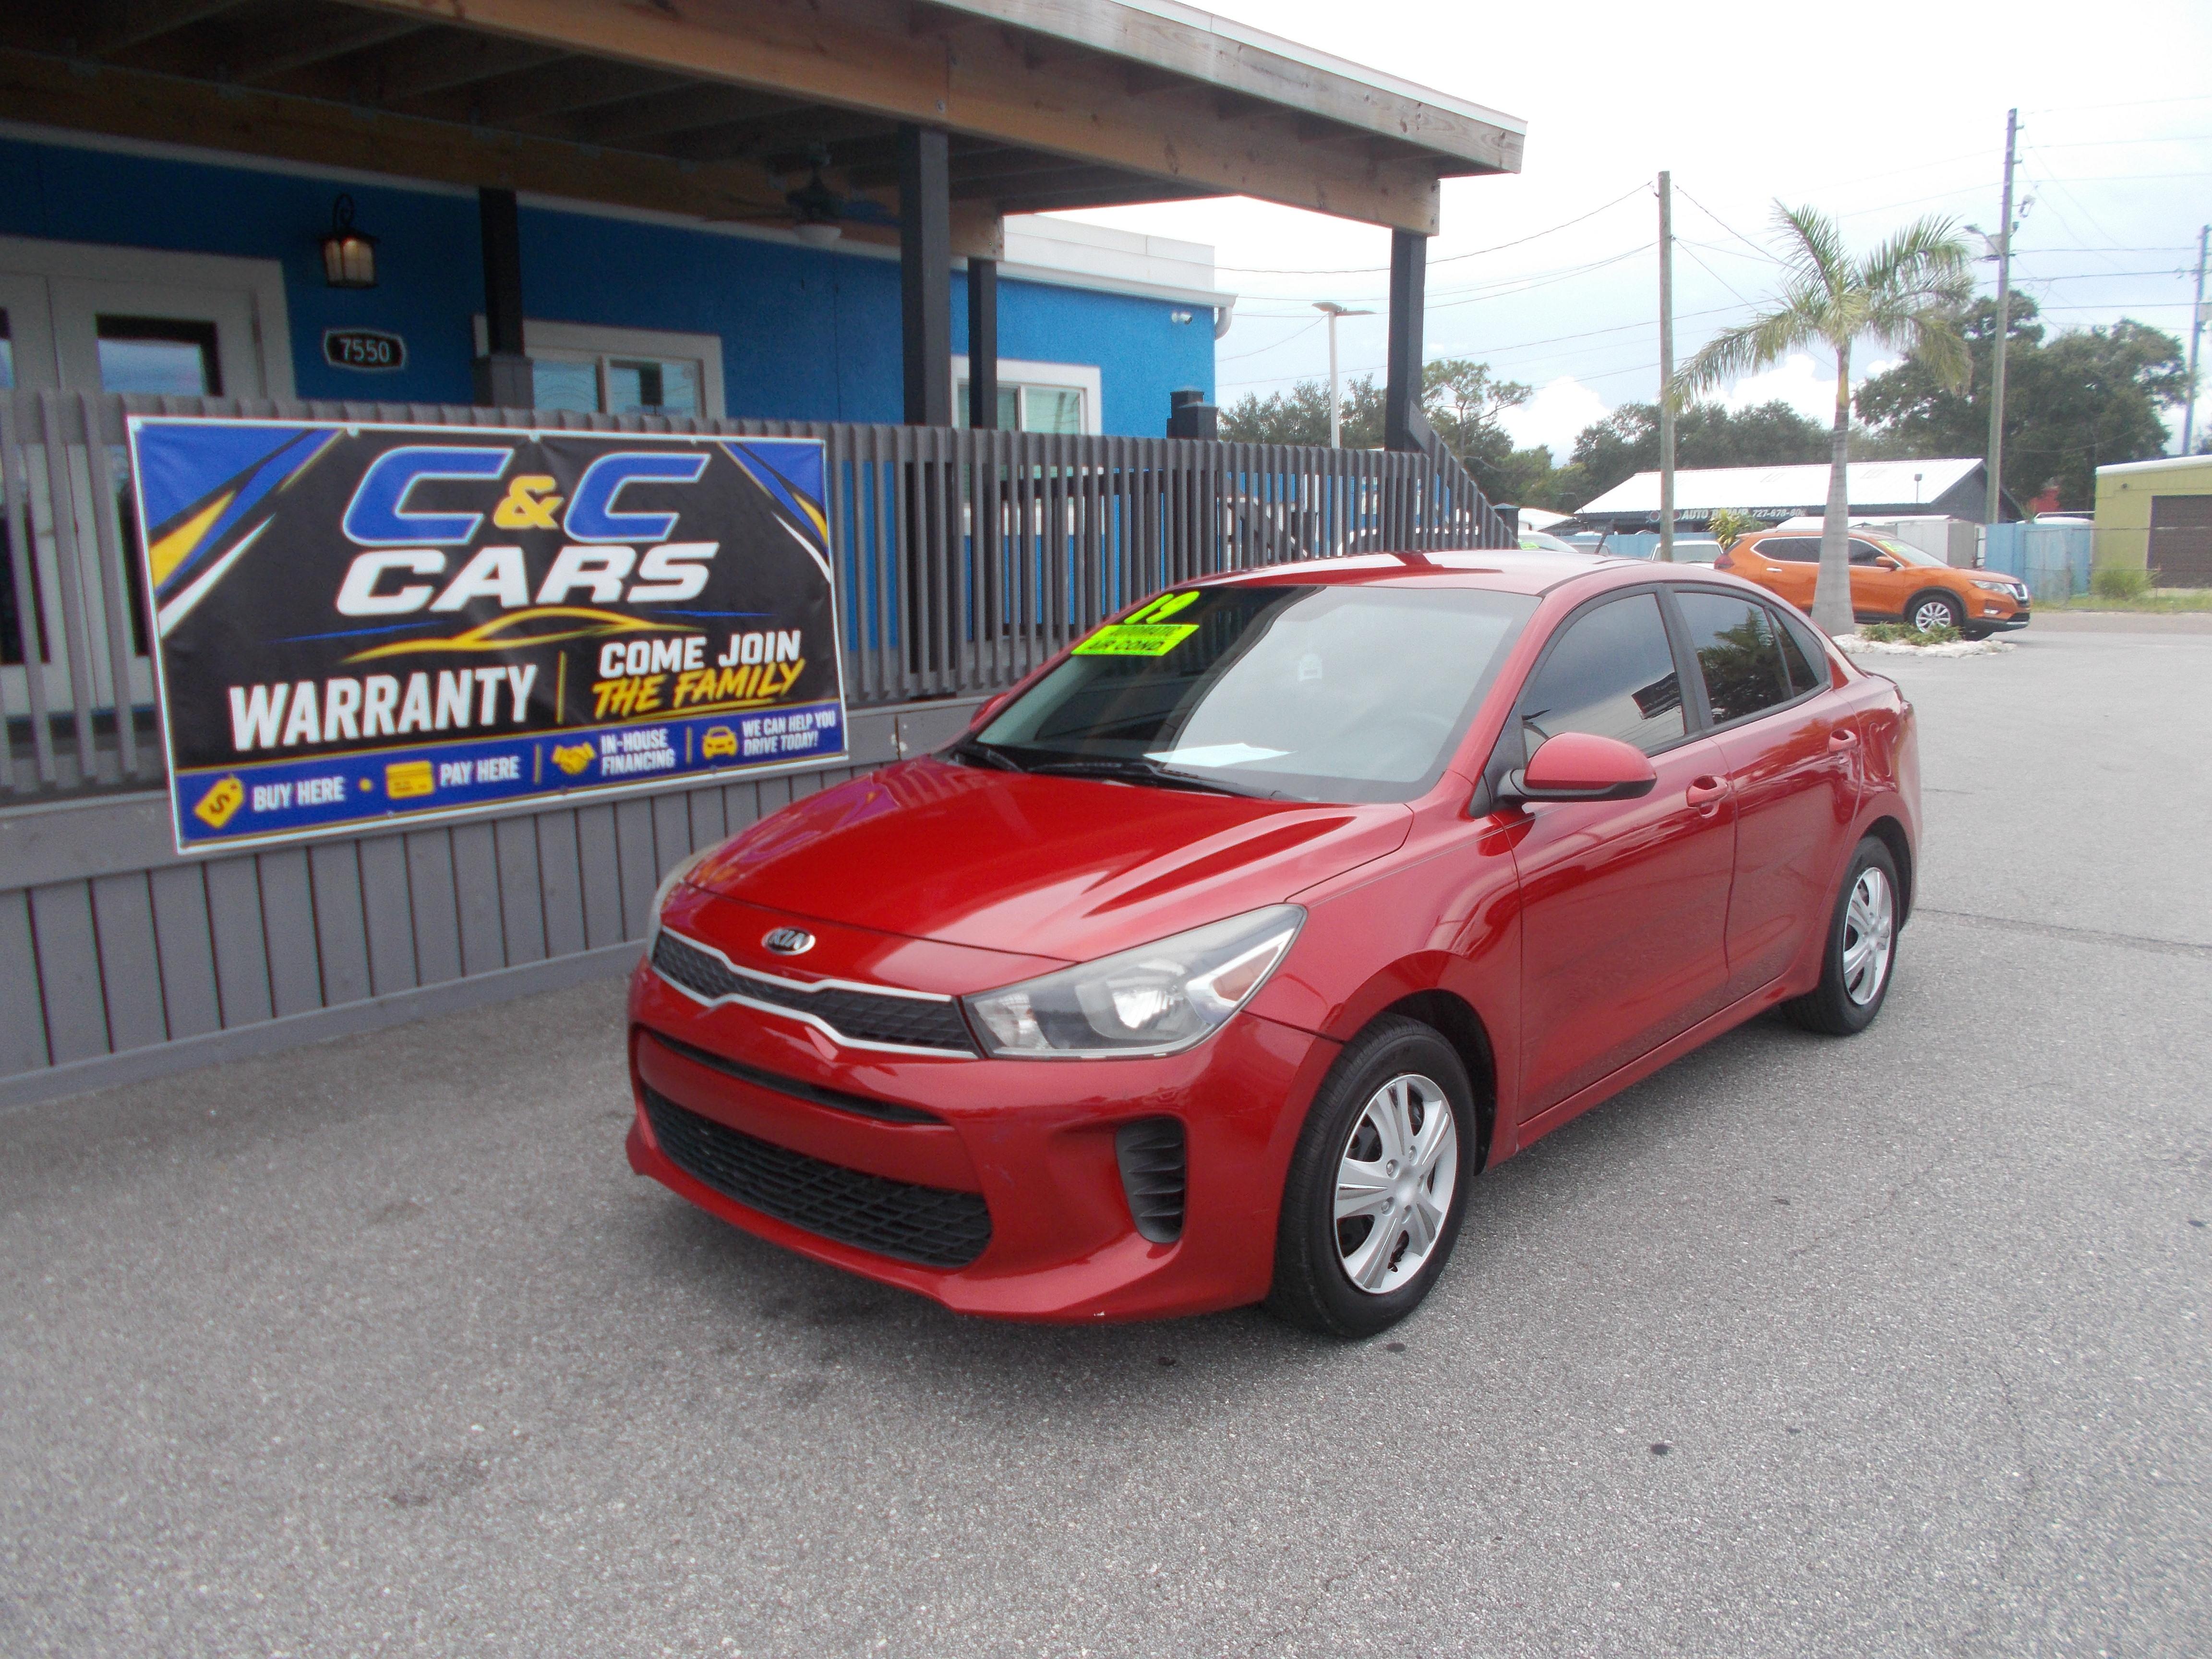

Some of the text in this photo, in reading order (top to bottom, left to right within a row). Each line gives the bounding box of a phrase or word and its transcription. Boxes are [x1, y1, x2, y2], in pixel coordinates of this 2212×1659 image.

[340, 338, 390, 362] 7550
[342, 445, 711, 545] C&C
[1681, 509, 1708, 520] AUTO
[337, 542, 720, 616] CARS
[599, 630, 801, 678] COME JOIN
[592, 658, 805, 719] THE FAMILY
[229, 663, 539, 751] WARRANTY
[743, 710, 836, 738] WE CAN HELP YOU
[601, 728, 668, 755] IN-HOUSE
[744, 731, 819, 757] DRIVE TODAY!
[440, 756, 521, 787] PAY HERE
[602, 748, 676, 777] FINANCING
[253, 776, 346, 812] BUY HERE
